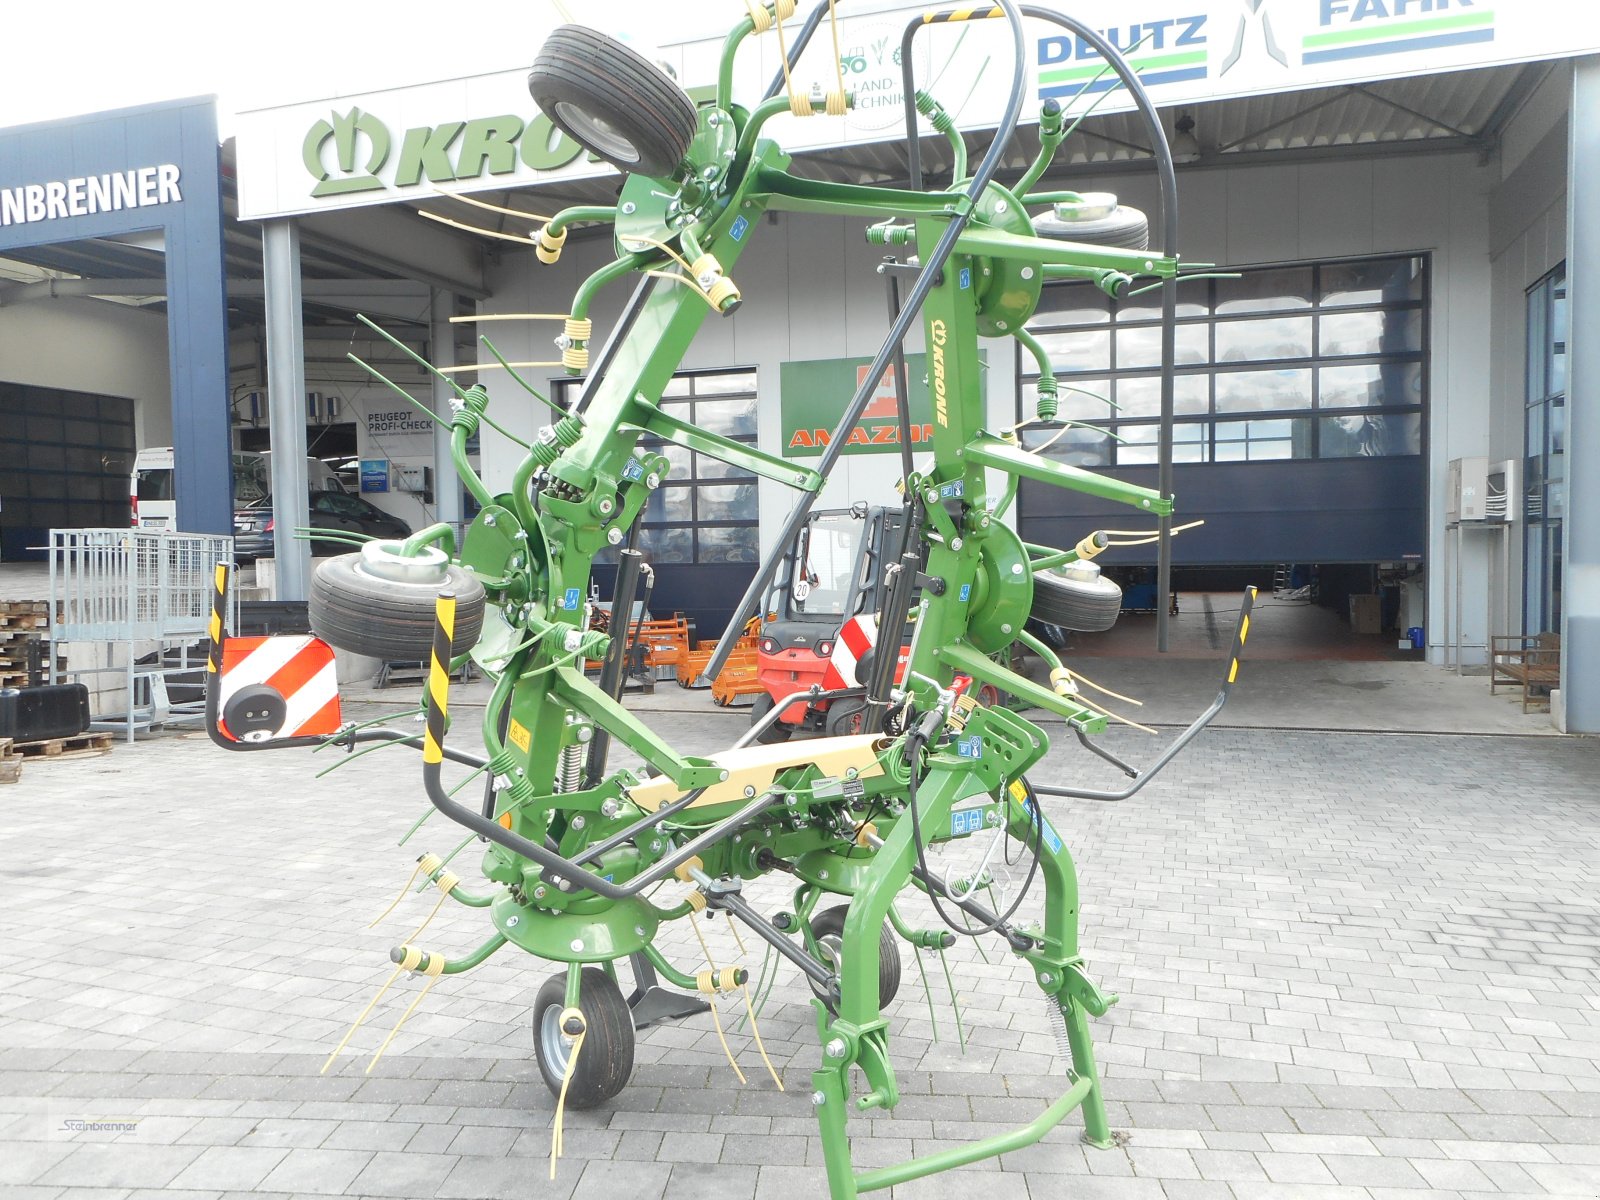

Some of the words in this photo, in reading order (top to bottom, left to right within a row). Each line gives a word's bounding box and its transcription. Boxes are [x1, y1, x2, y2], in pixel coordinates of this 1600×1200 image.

[1037, 14, 1207, 66] DEUTZ
[0, 164, 183, 226] NBRENNER
[932, 343, 948, 429] KRONE
[368, 411, 413, 422] PEUGEOT
[368, 420, 433, 431] PROFI-CHECK
[796, 584, 807, 597] 20
